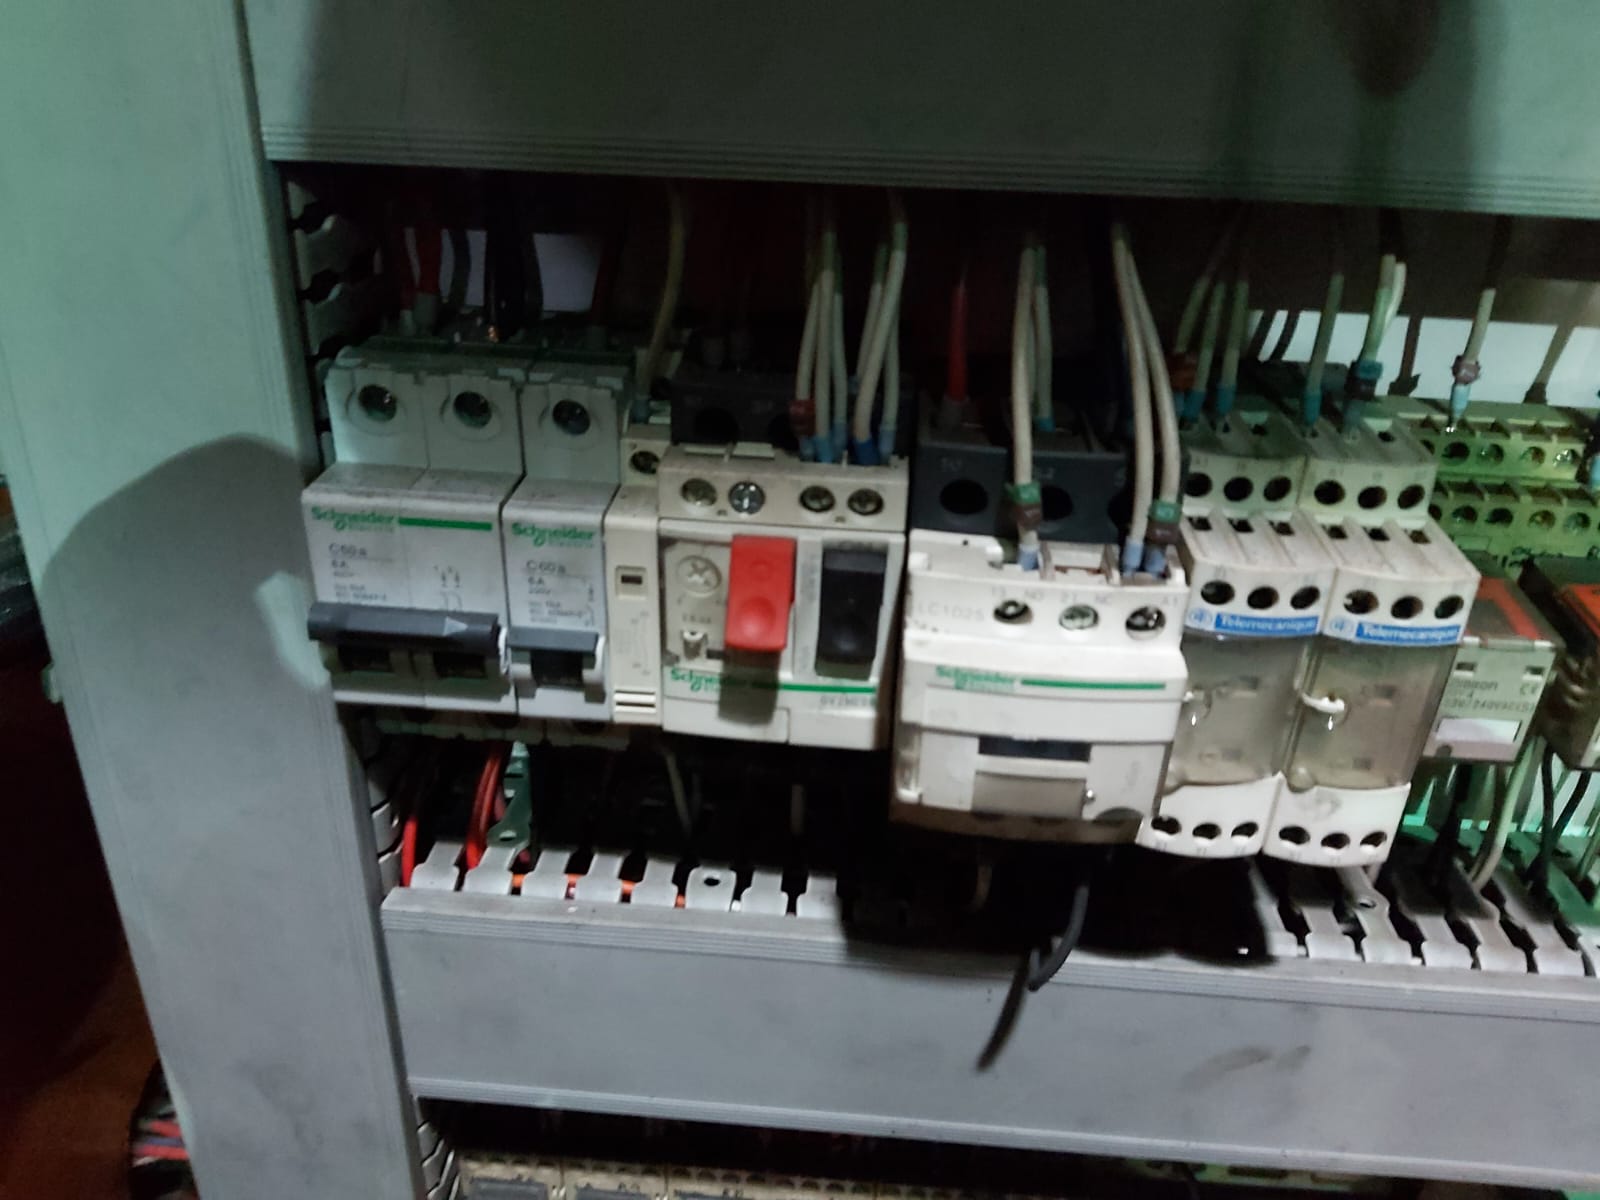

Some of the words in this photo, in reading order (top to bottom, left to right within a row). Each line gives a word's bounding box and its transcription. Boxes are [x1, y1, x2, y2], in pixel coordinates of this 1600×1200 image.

[311, 506, 395, 532] Schneider
[512, 522, 595, 547] Schneider
[1219, 614, 1317, 632] Telemecanique
[1362, 622, 1458, 641] Telemecanique
[935, 665, 1016, 691] Schneider
